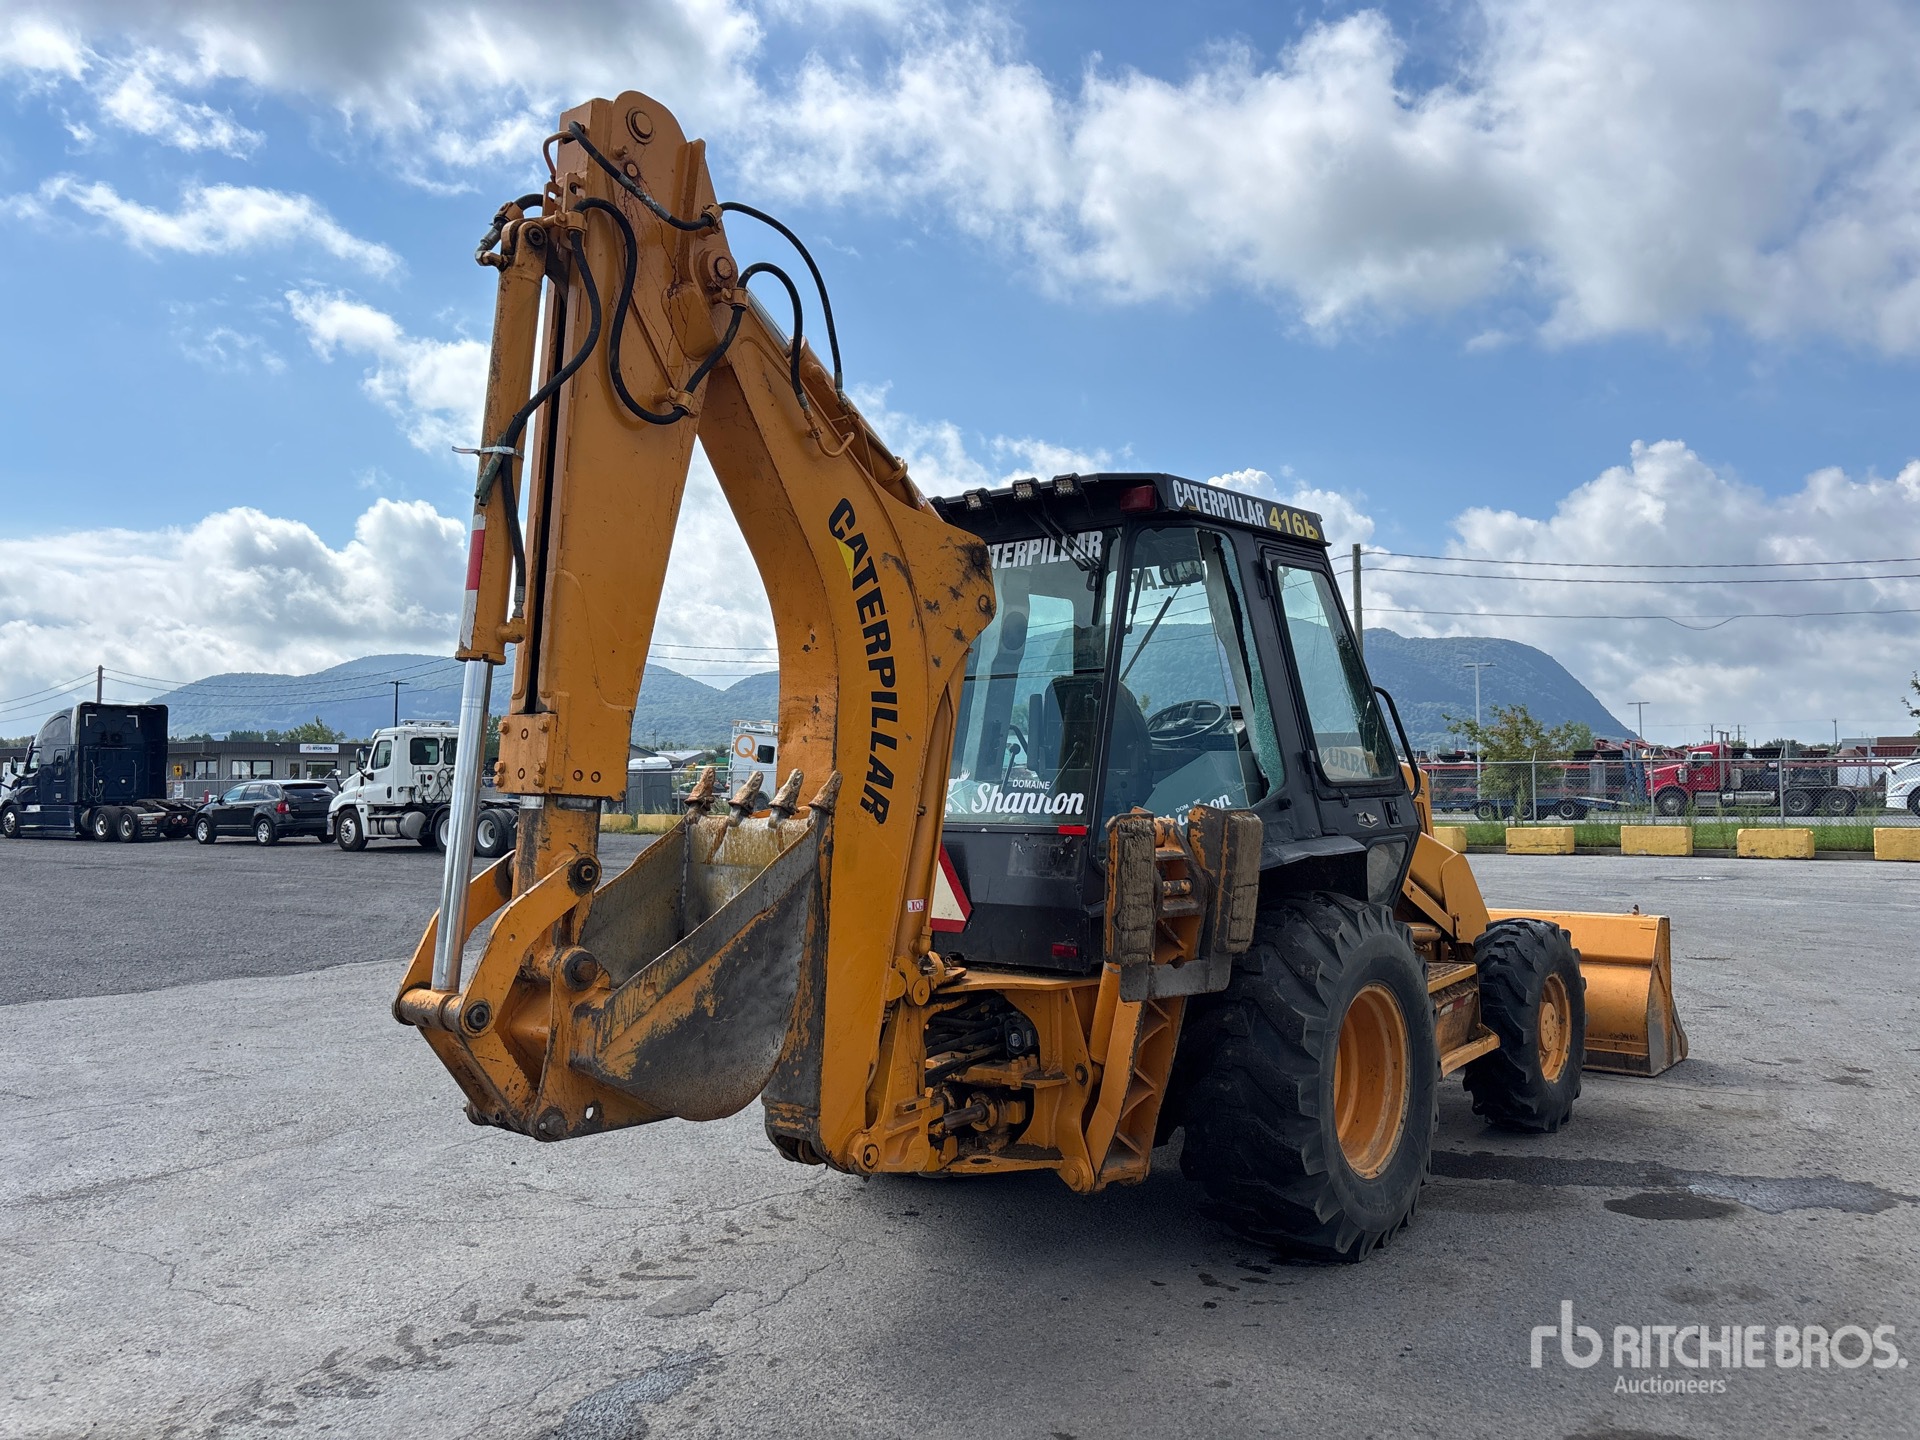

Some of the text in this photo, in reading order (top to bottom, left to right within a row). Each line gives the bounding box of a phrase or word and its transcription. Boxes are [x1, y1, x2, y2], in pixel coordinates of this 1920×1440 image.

[1172, 479, 1266, 528] CATERPILLAR
[987, 530, 1104, 570] TERPILLAR
[828, 497, 898, 825] CATERPILLAR
[971, 782, 1085, 815] Shannon
[1012, 779, 1051, 790] DOMAINE
